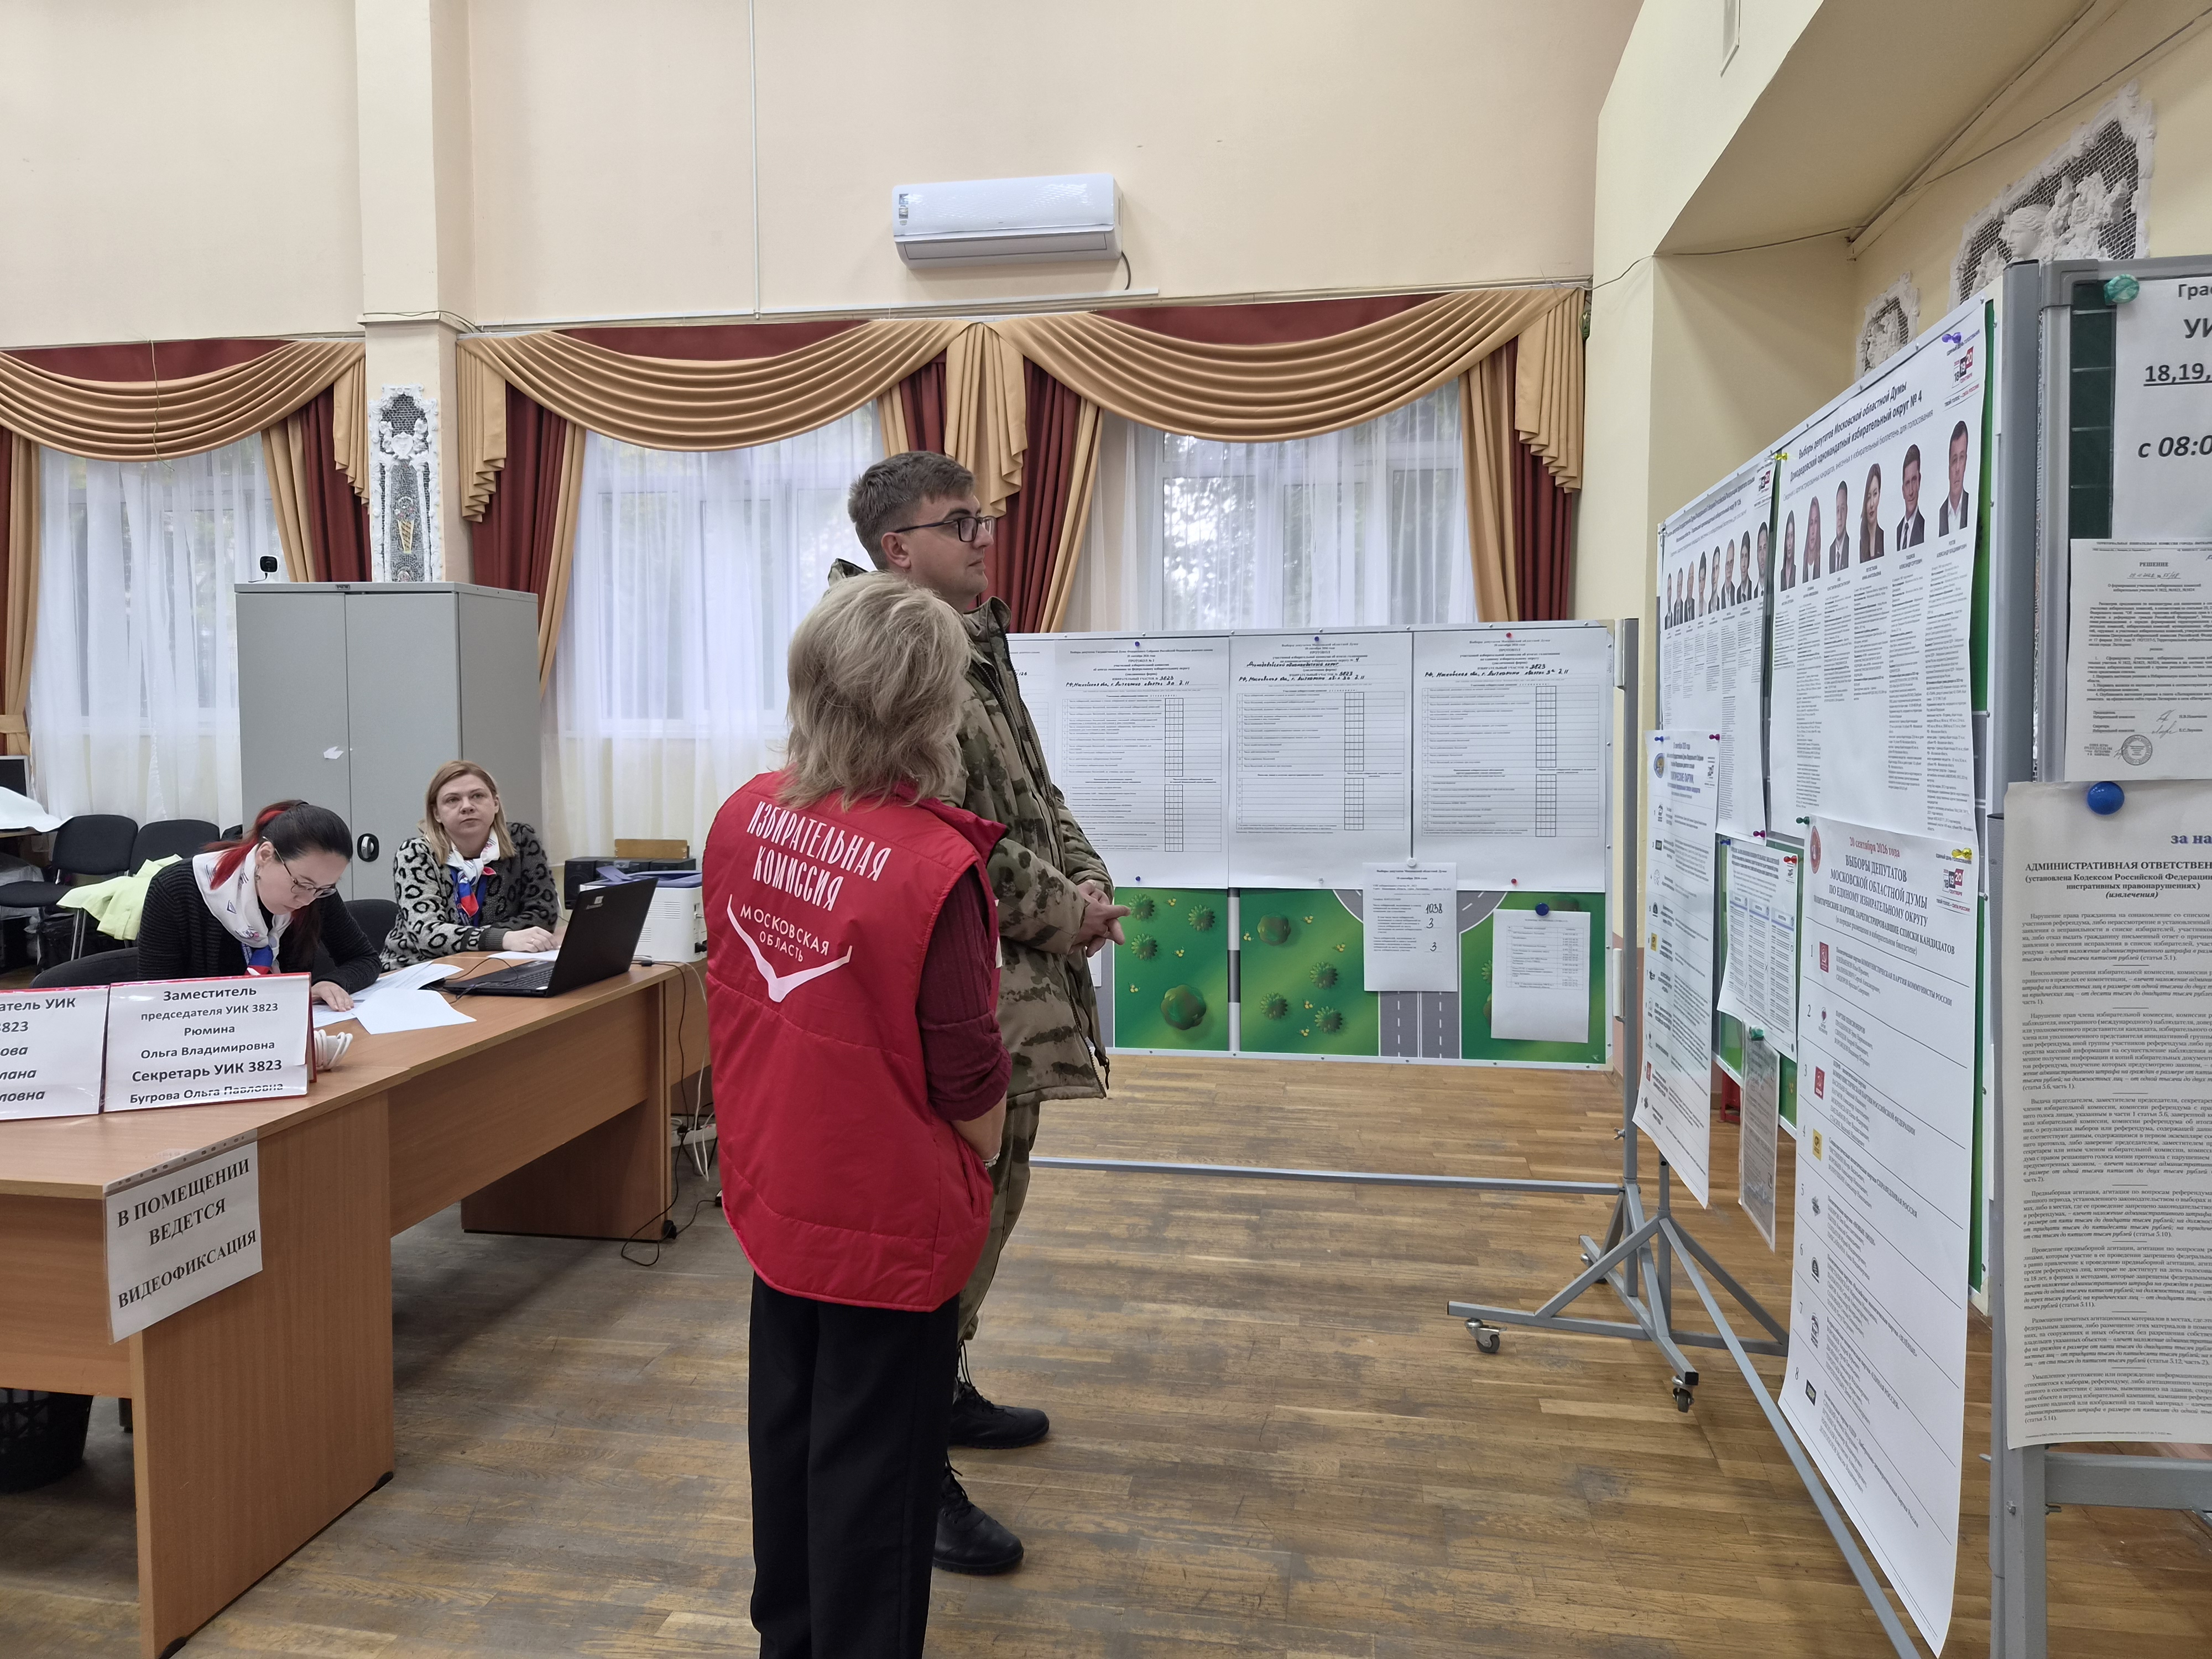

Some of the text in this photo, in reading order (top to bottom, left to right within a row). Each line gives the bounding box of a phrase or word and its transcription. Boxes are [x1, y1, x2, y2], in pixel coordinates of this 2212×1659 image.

[2178, 284, 2212, 300] Гра
[1966, 352, 1972, 364] 20
[2145, 363, 2211, 383] 18,19,
[1799, 381, 1907, 460] Выборы депутатов Московской областной Думы
[1790, 455, 1817, 484] Домодедовский
[1817, 433, 1851, 465] одномандатный
[1851, 408, 1891, 442] избирательный
[1892, 400, 1909, 418] округ
[1910, 393, 1917, 408] №
[1918, 390, 1922, 402] 4
[1853, 438, 1879, 459] избирательный
[1880, 429, 1899, 445] бюллетень
[1907, 409, 1933, 430] голосования
[2138, 442, 2151, 458] с
[747, 801, 891, 881] ИЗБИРАТЕЛЬНАЯ
[1849, 837, 1900, 858] 20 сентября 2026 года
[2171, 835, 2188, 844] за
[1845, 854, 1907, 882] ВЫБОРЫ ДЕПУТАТОВ
[2025, 861, 2212, 871] АДМИНИСТРАТИВНАЯ ОТВЕТСТВЕН
[753, 845, 844, 911] КОМИССИЯ
[1955, 872, 1961, 882] 20
[2025, 875, 2072, 883] (установлена
[1830, 868, 1928, 909] МОСКОВСКОЙ ОБЛАСТНОЙ ДУМЫ
[2122, 882, 2200, 891] правонарушениях)
[1425, 903, 1443, 914] 1038
[1829, 884, 1928, 927] ПО ЕДИНОМУ ИЗБИРАТЕЛЬНОМУ ОКРУГУ
[740, 904, 830, 956] МОСКОВСКАЯ
[1426, 918, 1433, 928] 3
[1855, 910, 1899, 935] ЗАРЕГИСТРИРОВАВШИЕ
[1900, 927, 1919, 942] СПИСКИ
[1919, 935, 1955, 955] КАНДИДАТОВ
[759, 931, 804, 962] ОБЛАСТЬ
[1430, 942, 1437, 952] 3
[164, 987, 257, 1001] Заместитель
[1907, 980, 1936, 999] КОММУНИСТЫ
[1936, 993, 1952, 1006] РОССИИ
[45, 998, 76, 1009] УИК
[1807, 1005, 1811, 1018] 2
[141, 1003, 279, 1022] председателя УИК 3823
[0, 1021, 29, 1032] 823
[184, 1026, 236, 1036] Рюмина
[140, 1042, 275, 1059] Ольга Владимировна
[132, 1060, 282, 1082] Секретарь УИК 3823
[1804, 1065, 1807, 1077] 3
[130, 1083, 284, 1104] Бугрова Ольга Павловна
[1802, 1125, 1806, 1138] 4
[117, 1158, 250, 1228] В ПОМЕЩЕНИИ
[1801, 1184, 1804, 1196] 5
[1902, 1201, 1917, 1218] РОССИЯ
[148, 1197, 226, 1246] ВЕДЕТСЯ
[1800, 1244, 1803, 1256] 6
[117, 1229, 257, 1309] ВИДЕОФИКСАЦИЯ
[1799, 1301, 1803, 1314] 7
[1795, 1366, 1799, 1380] 8
